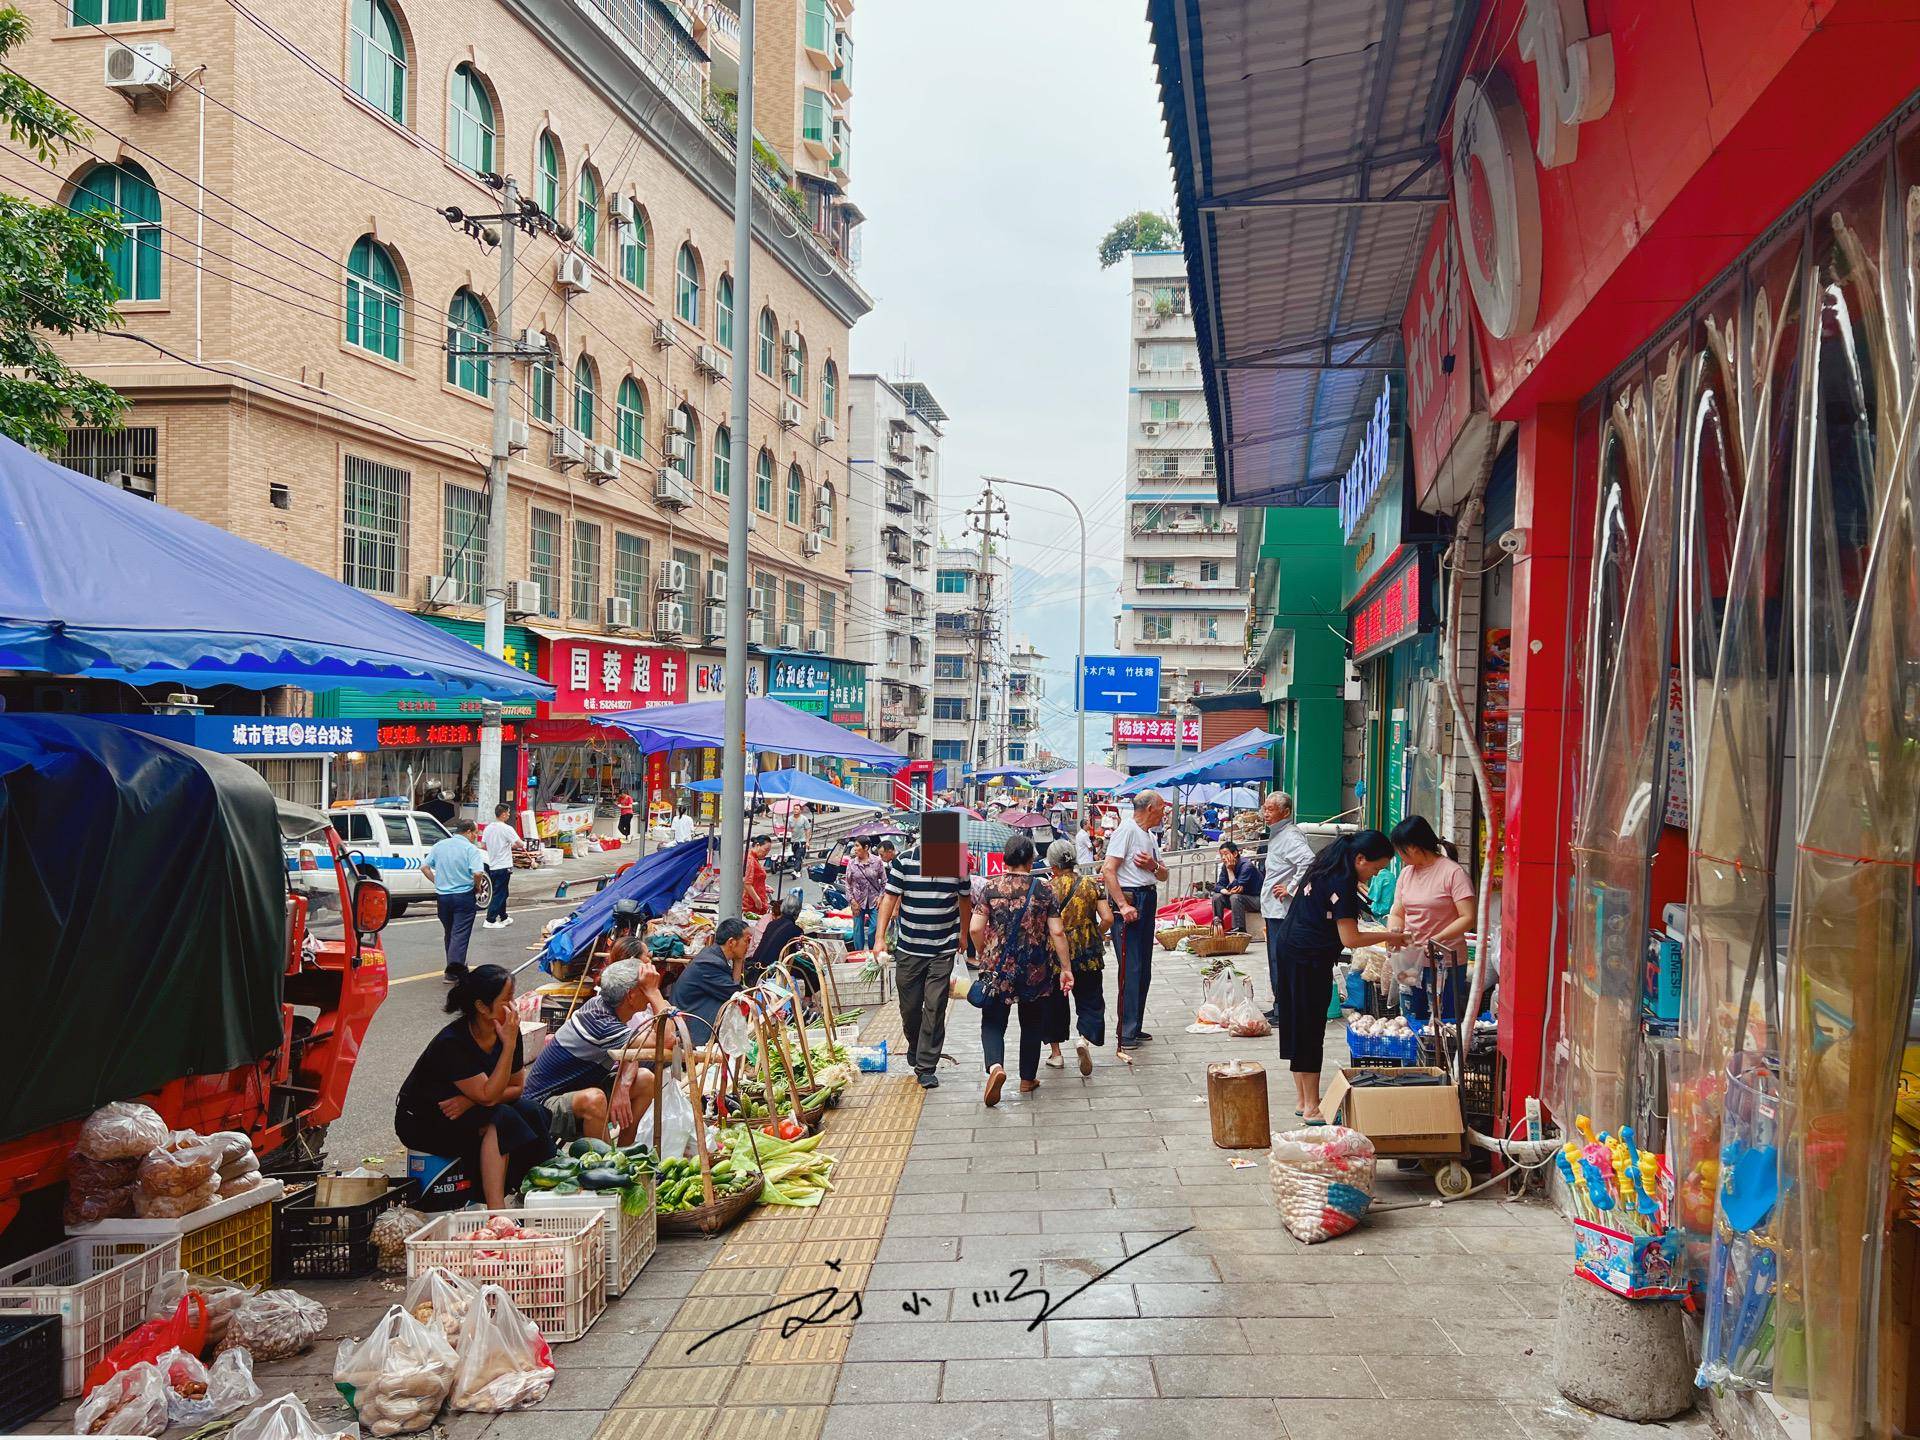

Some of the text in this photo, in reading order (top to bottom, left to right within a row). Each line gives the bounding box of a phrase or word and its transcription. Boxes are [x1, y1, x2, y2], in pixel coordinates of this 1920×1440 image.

[571, 648, 678, 696] 国蓉超市
[1126, 667, 1154, 677] 竹枝路
[232, 724, 353, 745] 城市管理 综合执法
[1670, 943, 1681, 997] NEMESIS
